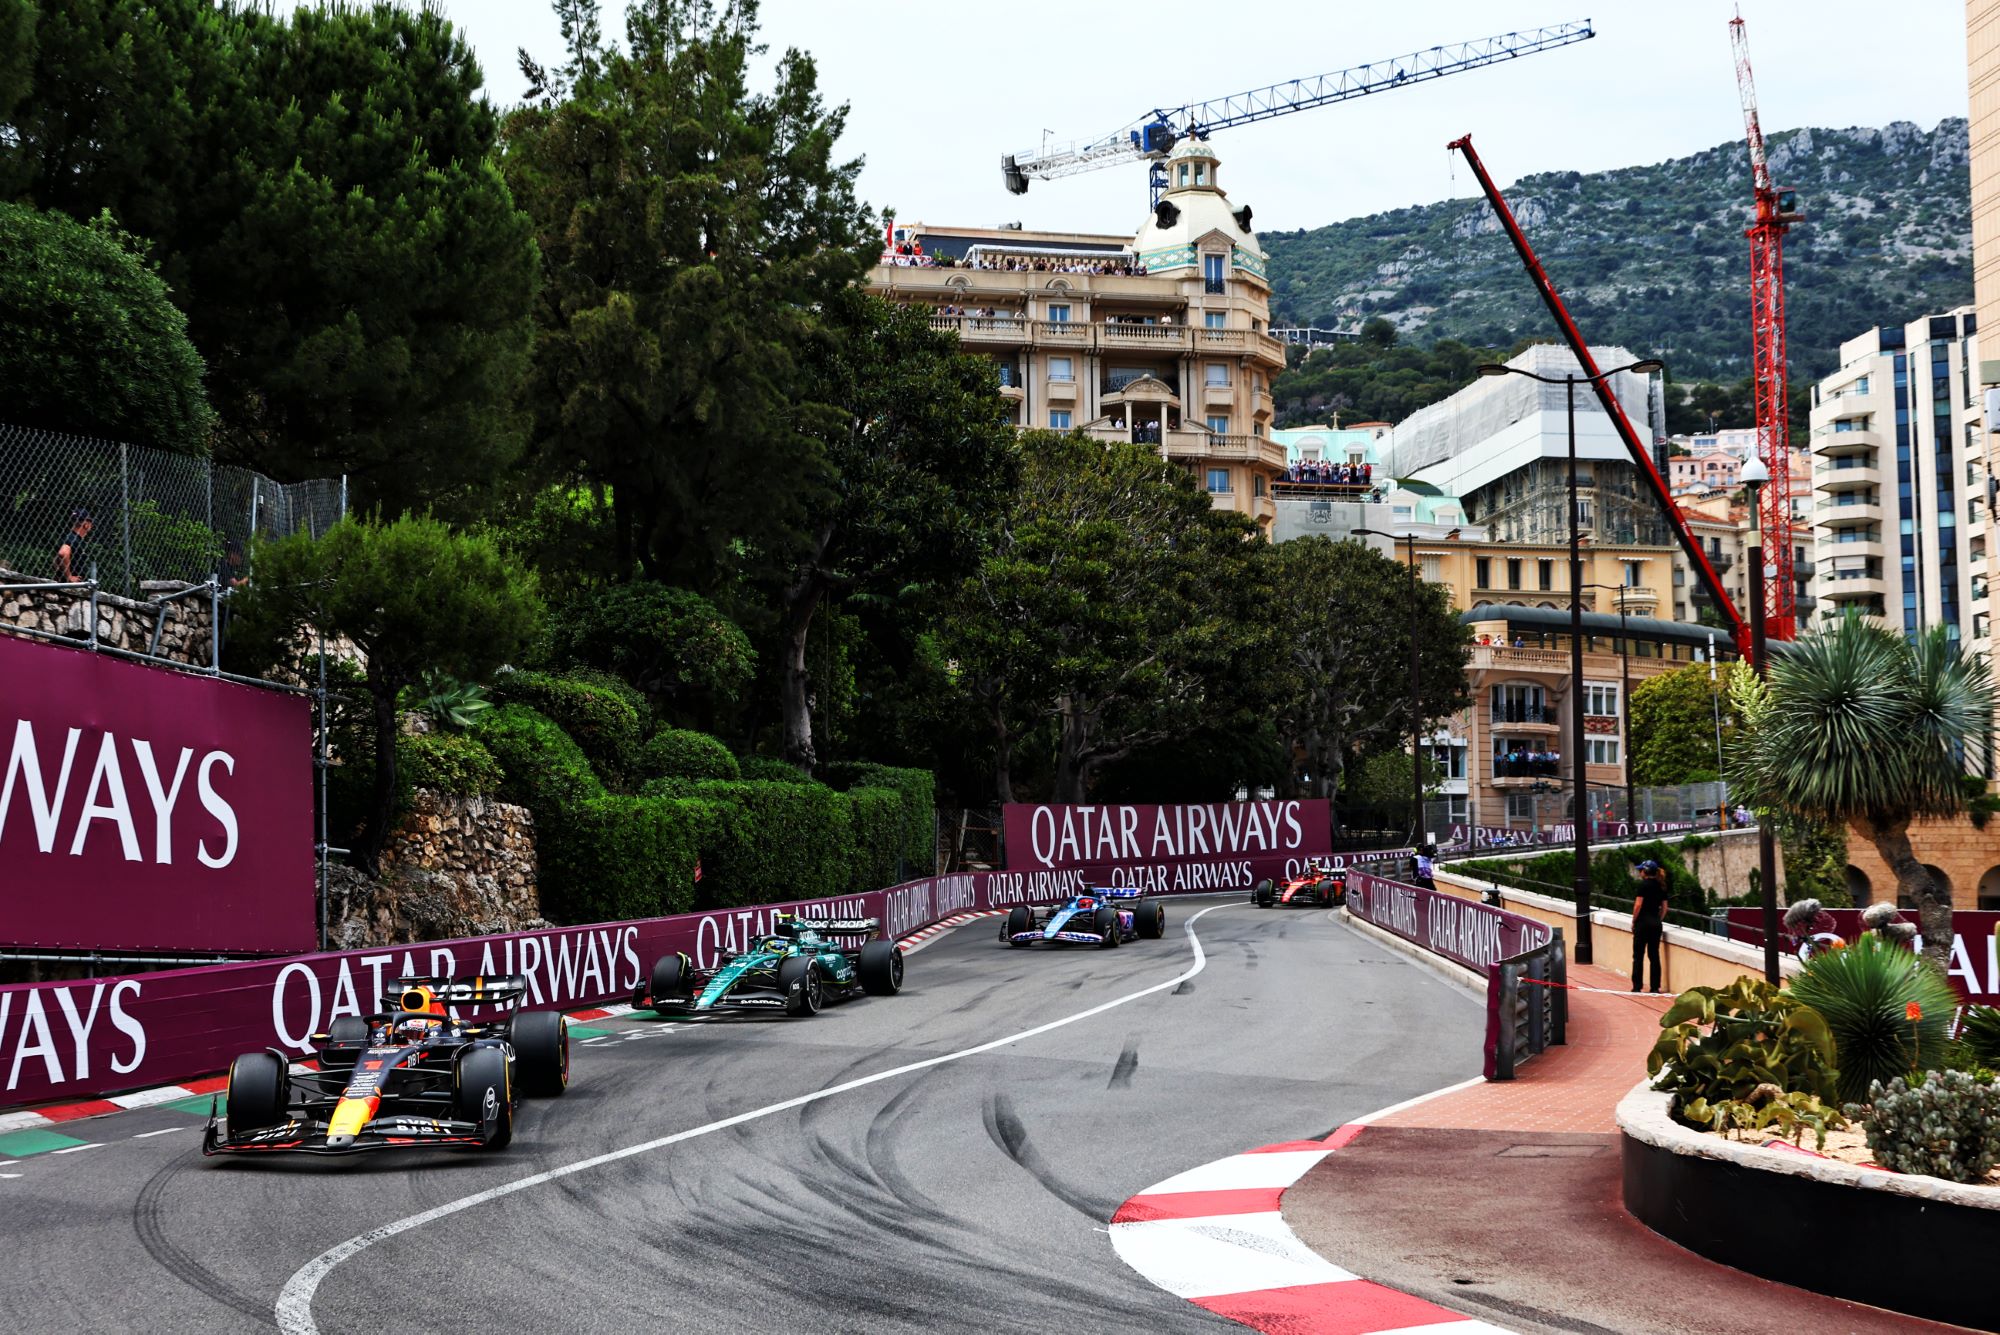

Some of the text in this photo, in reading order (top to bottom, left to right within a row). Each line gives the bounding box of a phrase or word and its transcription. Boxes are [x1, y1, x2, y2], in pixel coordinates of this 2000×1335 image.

[1031, 800, 1303, 868] QATAR AIRWAYS
[987, 869, 1084, 909] QATAR AIRWAYS
[1112, 861, 1253, 892] QATAR AIRWAYS
[795, 899, 866, 950] WAYS
[886, 882, 930, 941] QATAR AIRWAYS
[1370, 880, 1389, 924] QATAR
[1391, 885, 1417, 937] AIRWAYS
[1428, 895, 1502, 967] QATAR AIRWAYS
[473, 926, 641, 1017] AIRWAYS
